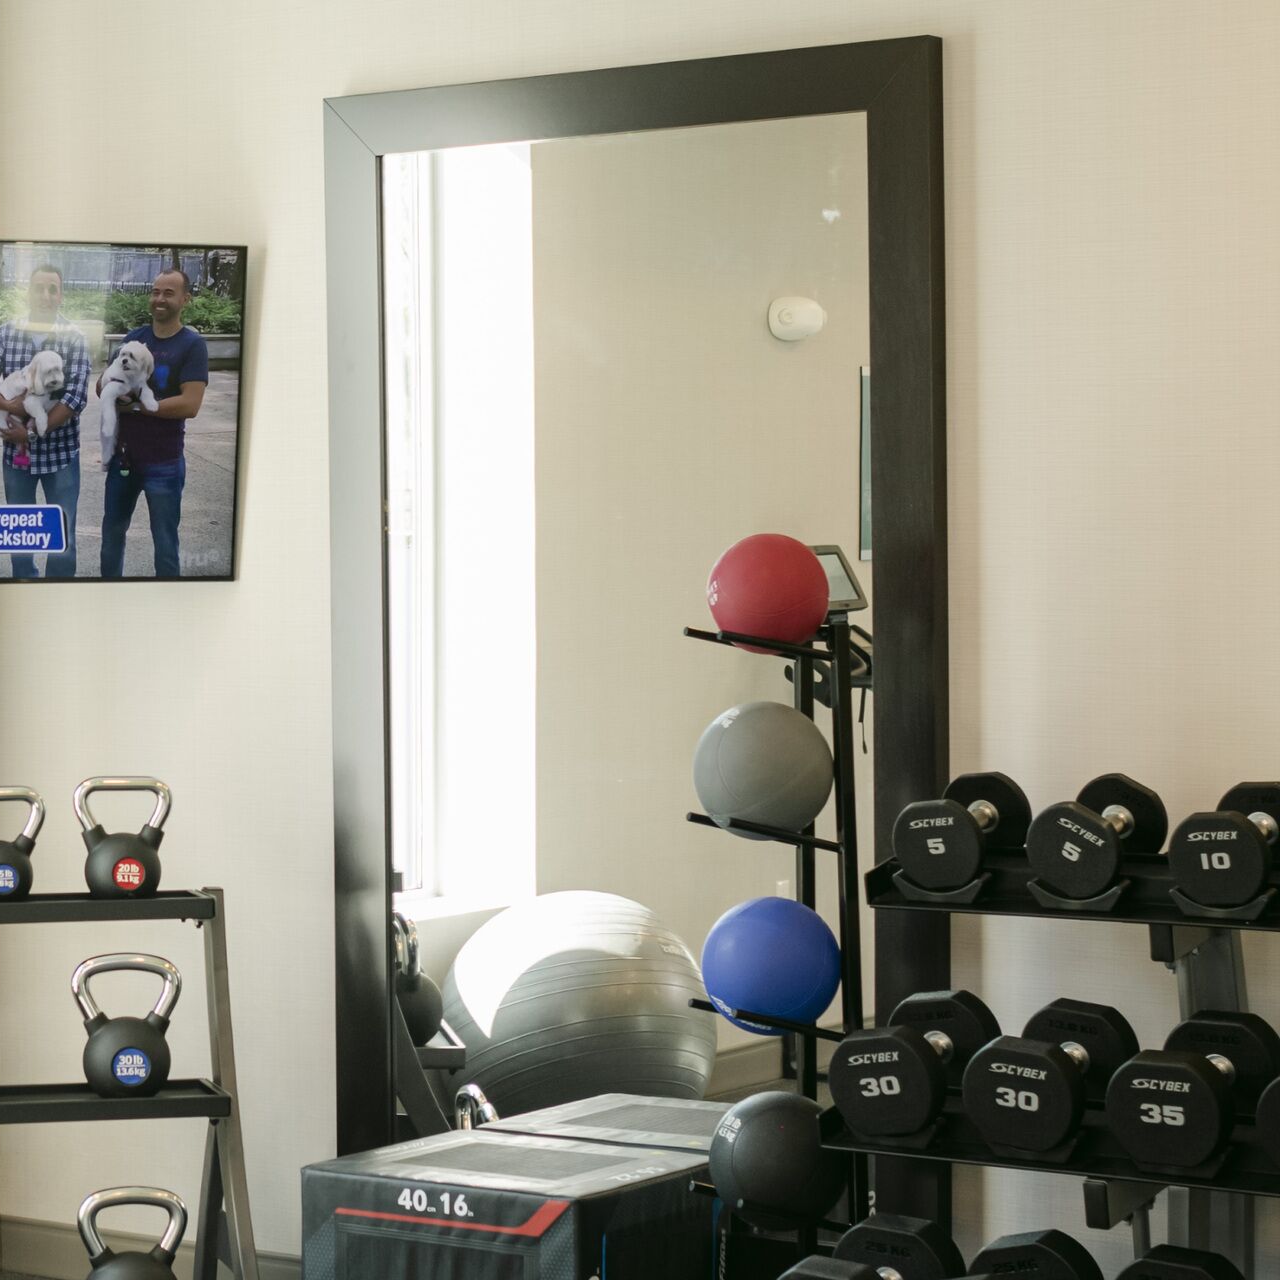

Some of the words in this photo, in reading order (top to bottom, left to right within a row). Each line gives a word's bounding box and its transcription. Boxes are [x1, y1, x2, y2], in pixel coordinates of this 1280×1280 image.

[923, 817, 955, 827] CYBEX
[1070, 825, 1107, 847] CYBEX
[1202, 831, 1238, 840] CYBEX
[926, 838, 946, 855] 5
[1061, 841, 1082, 862] 5
[118, 863, 130, 873] 20
[130, 863, 140, 873] lb
[1200, 852, 1231, 870] 10
[5, 869, 14, 878] lb
[118, 1054, 133, 1065] 30
[133, 1054, 144, 1065] lb
[864, 1051, 900, 1064] CYBEX
[116, 1067, 134, 1077] 13.6
[134, 1067, 146, 1078] kg
[1006, 1065, 1048, 1081] CYBEX
[859, 1075, 902, 1097] 30
[1149, 1079, 1192, 1093] CYBEX
[995, 1086, 1039, 1112] 30
[1140, 1103, 1186, 1126] 35
[864, 1240, 888, 1254] 25
[890, 1244, 912, 1258] KG
